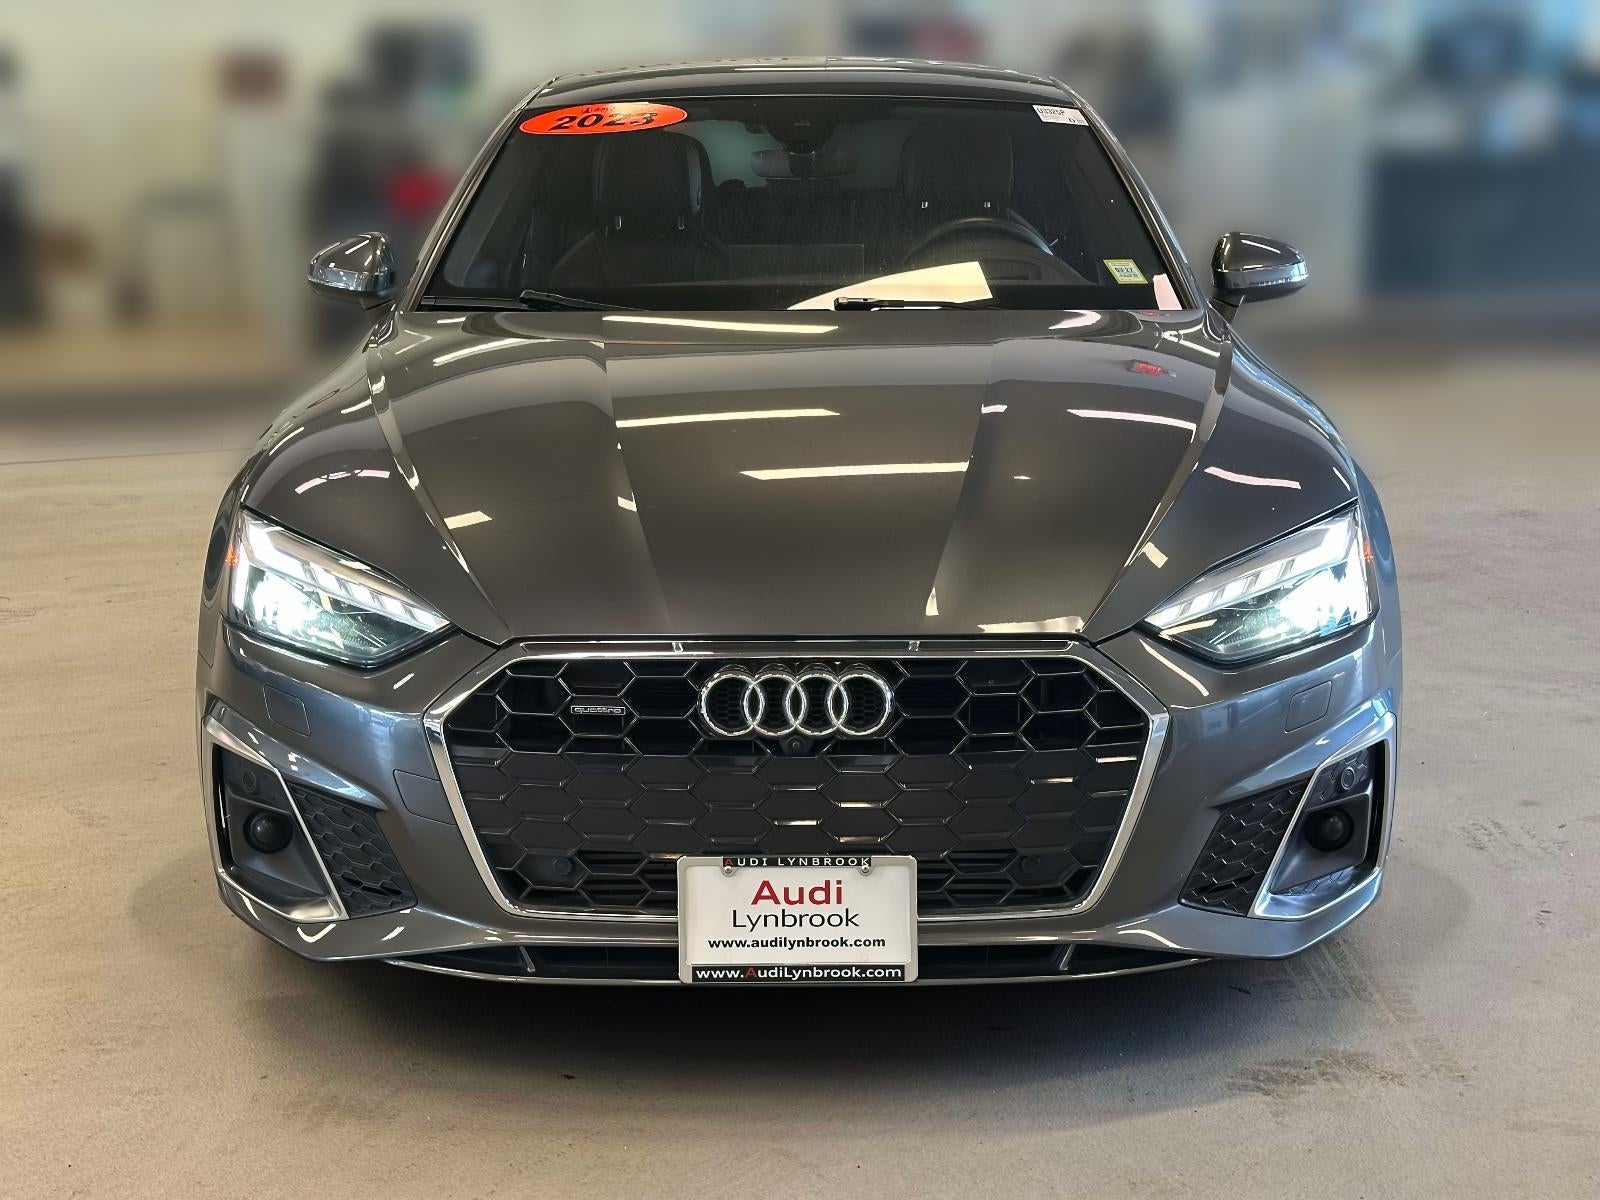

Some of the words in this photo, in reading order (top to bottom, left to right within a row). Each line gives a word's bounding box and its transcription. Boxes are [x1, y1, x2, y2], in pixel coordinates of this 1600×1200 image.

[724, 857, 768, 866] AUDI
[778, 857, 870, 867] LYNBROOK
[751, 880, 843, 905] Audi
[732, 908, 860, 932] Lynbrook
[708, 937, 886, 949] www.audilynbrook.com
[696, 967, 902, 981] www.AudiLynbrook.com
